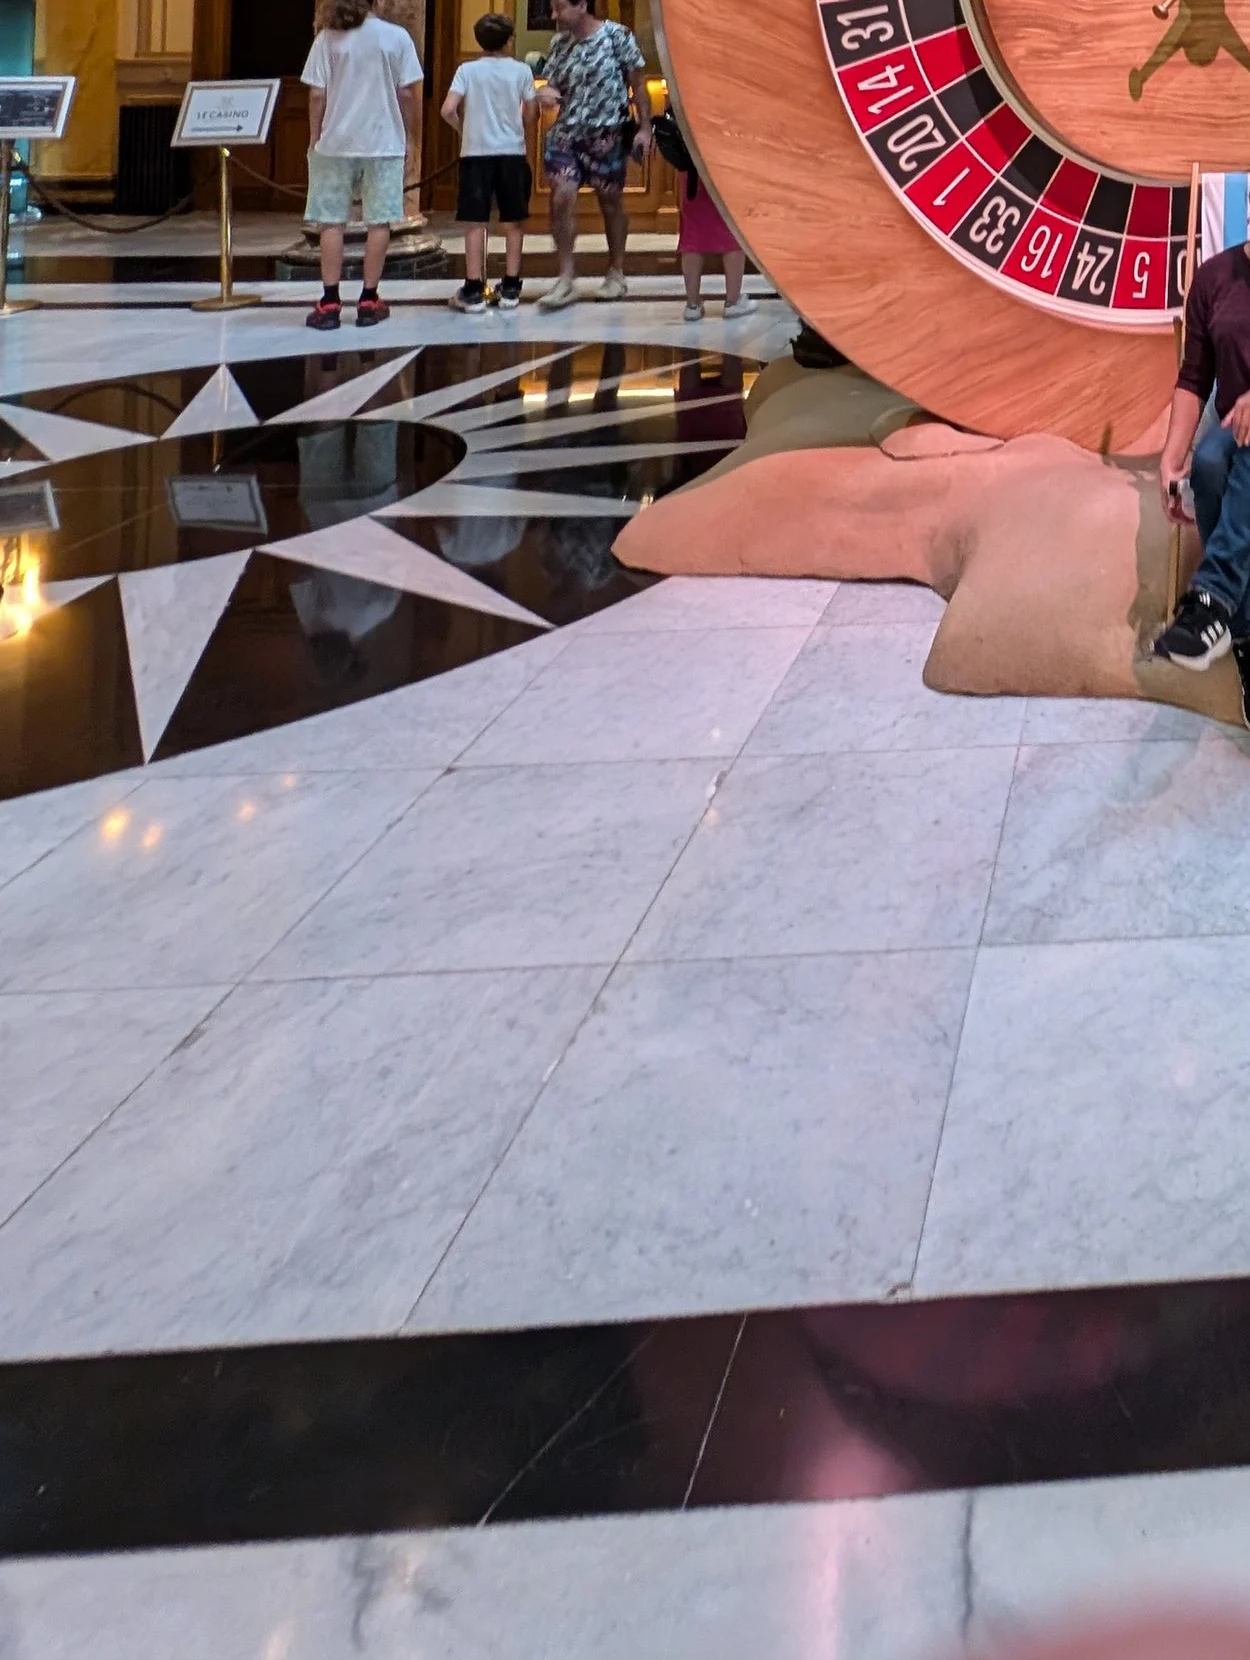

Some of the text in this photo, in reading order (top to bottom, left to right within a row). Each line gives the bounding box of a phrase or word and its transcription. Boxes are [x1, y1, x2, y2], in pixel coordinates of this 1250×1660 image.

[836, 4, 894, 51] 31
[209, 109, 249, 120] CASINO
[856, 64, 915, 115] 14
[887, 114, 947, 172] 20
[933, 167, 970, 207] 1
[968, 195, 1021, 254] 33
[1021, 225, 1063, 280] 16
[1070, 241, 1115, 296] 24
[1132, 251, 1150, 300] 5
